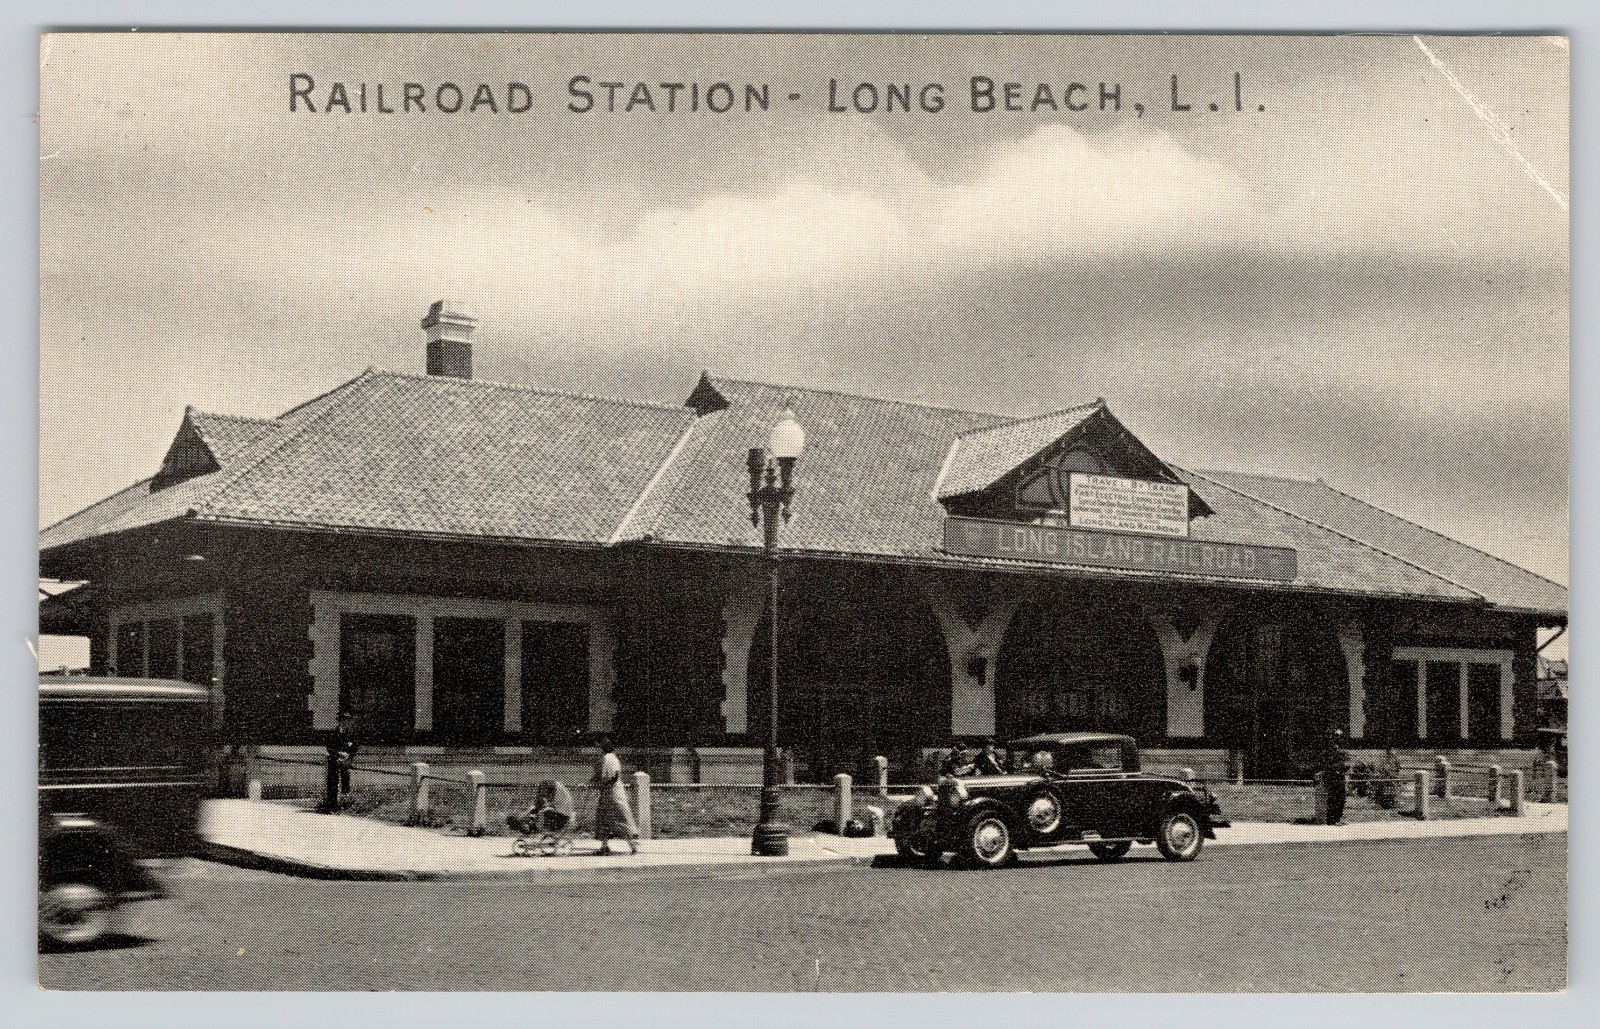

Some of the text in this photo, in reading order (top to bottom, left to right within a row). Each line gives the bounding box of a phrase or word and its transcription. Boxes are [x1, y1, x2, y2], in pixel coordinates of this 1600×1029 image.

[1086, 475, 1125, 487] TRAVEL
[1131, 480, 1144, 489] BY
[1147, 482, 1177, 493] TRAIN
[1079, 517, 1104, 526] LONG
[1105, 519, 1136, 529] ISLAND
[1137, 522, 1180, 533] RAILROAD
[997, 528, 1256, 571] LONG ISLAND RAILROAD
